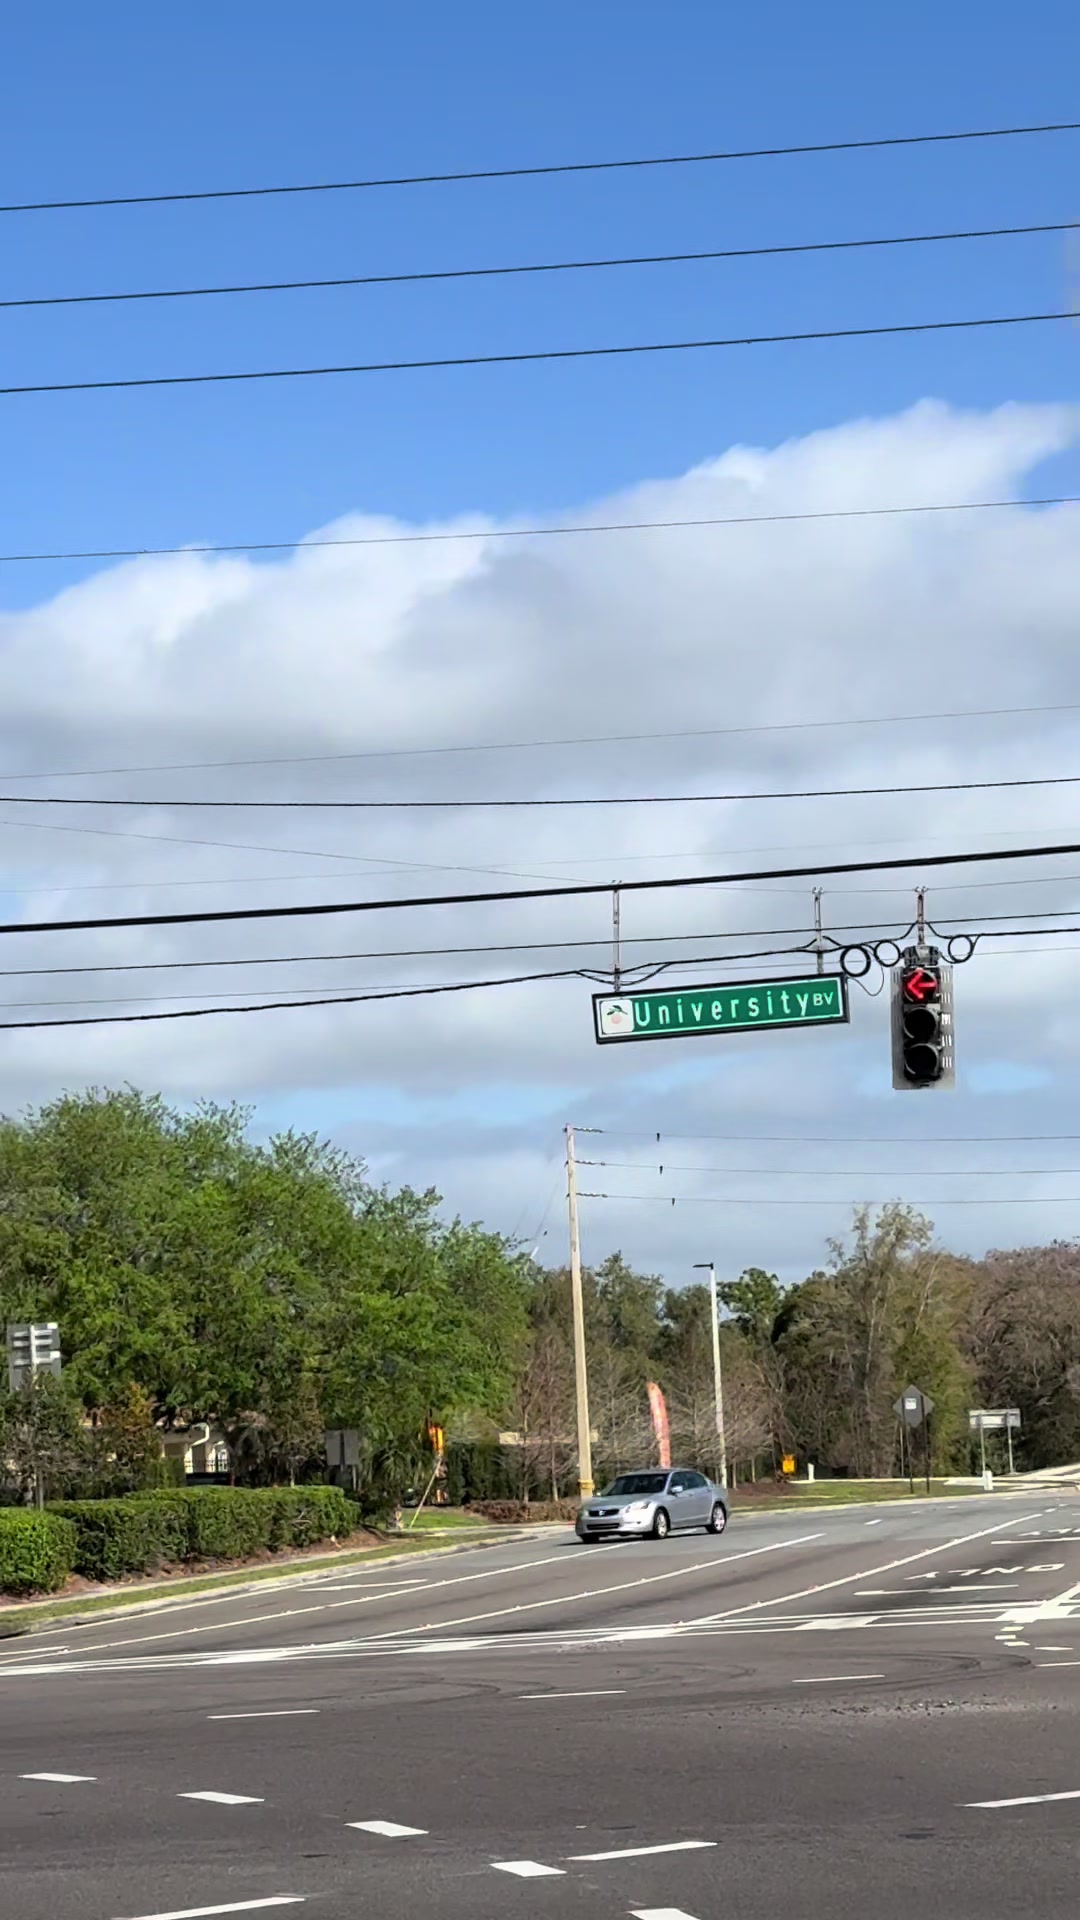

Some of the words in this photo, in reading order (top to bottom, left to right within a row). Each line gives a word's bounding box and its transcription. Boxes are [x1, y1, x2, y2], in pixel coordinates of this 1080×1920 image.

[635, 990, 809, 1027] University
[813, 991, 835, 1007] BV
[904, 1563, 1066, 1581] ONLY
